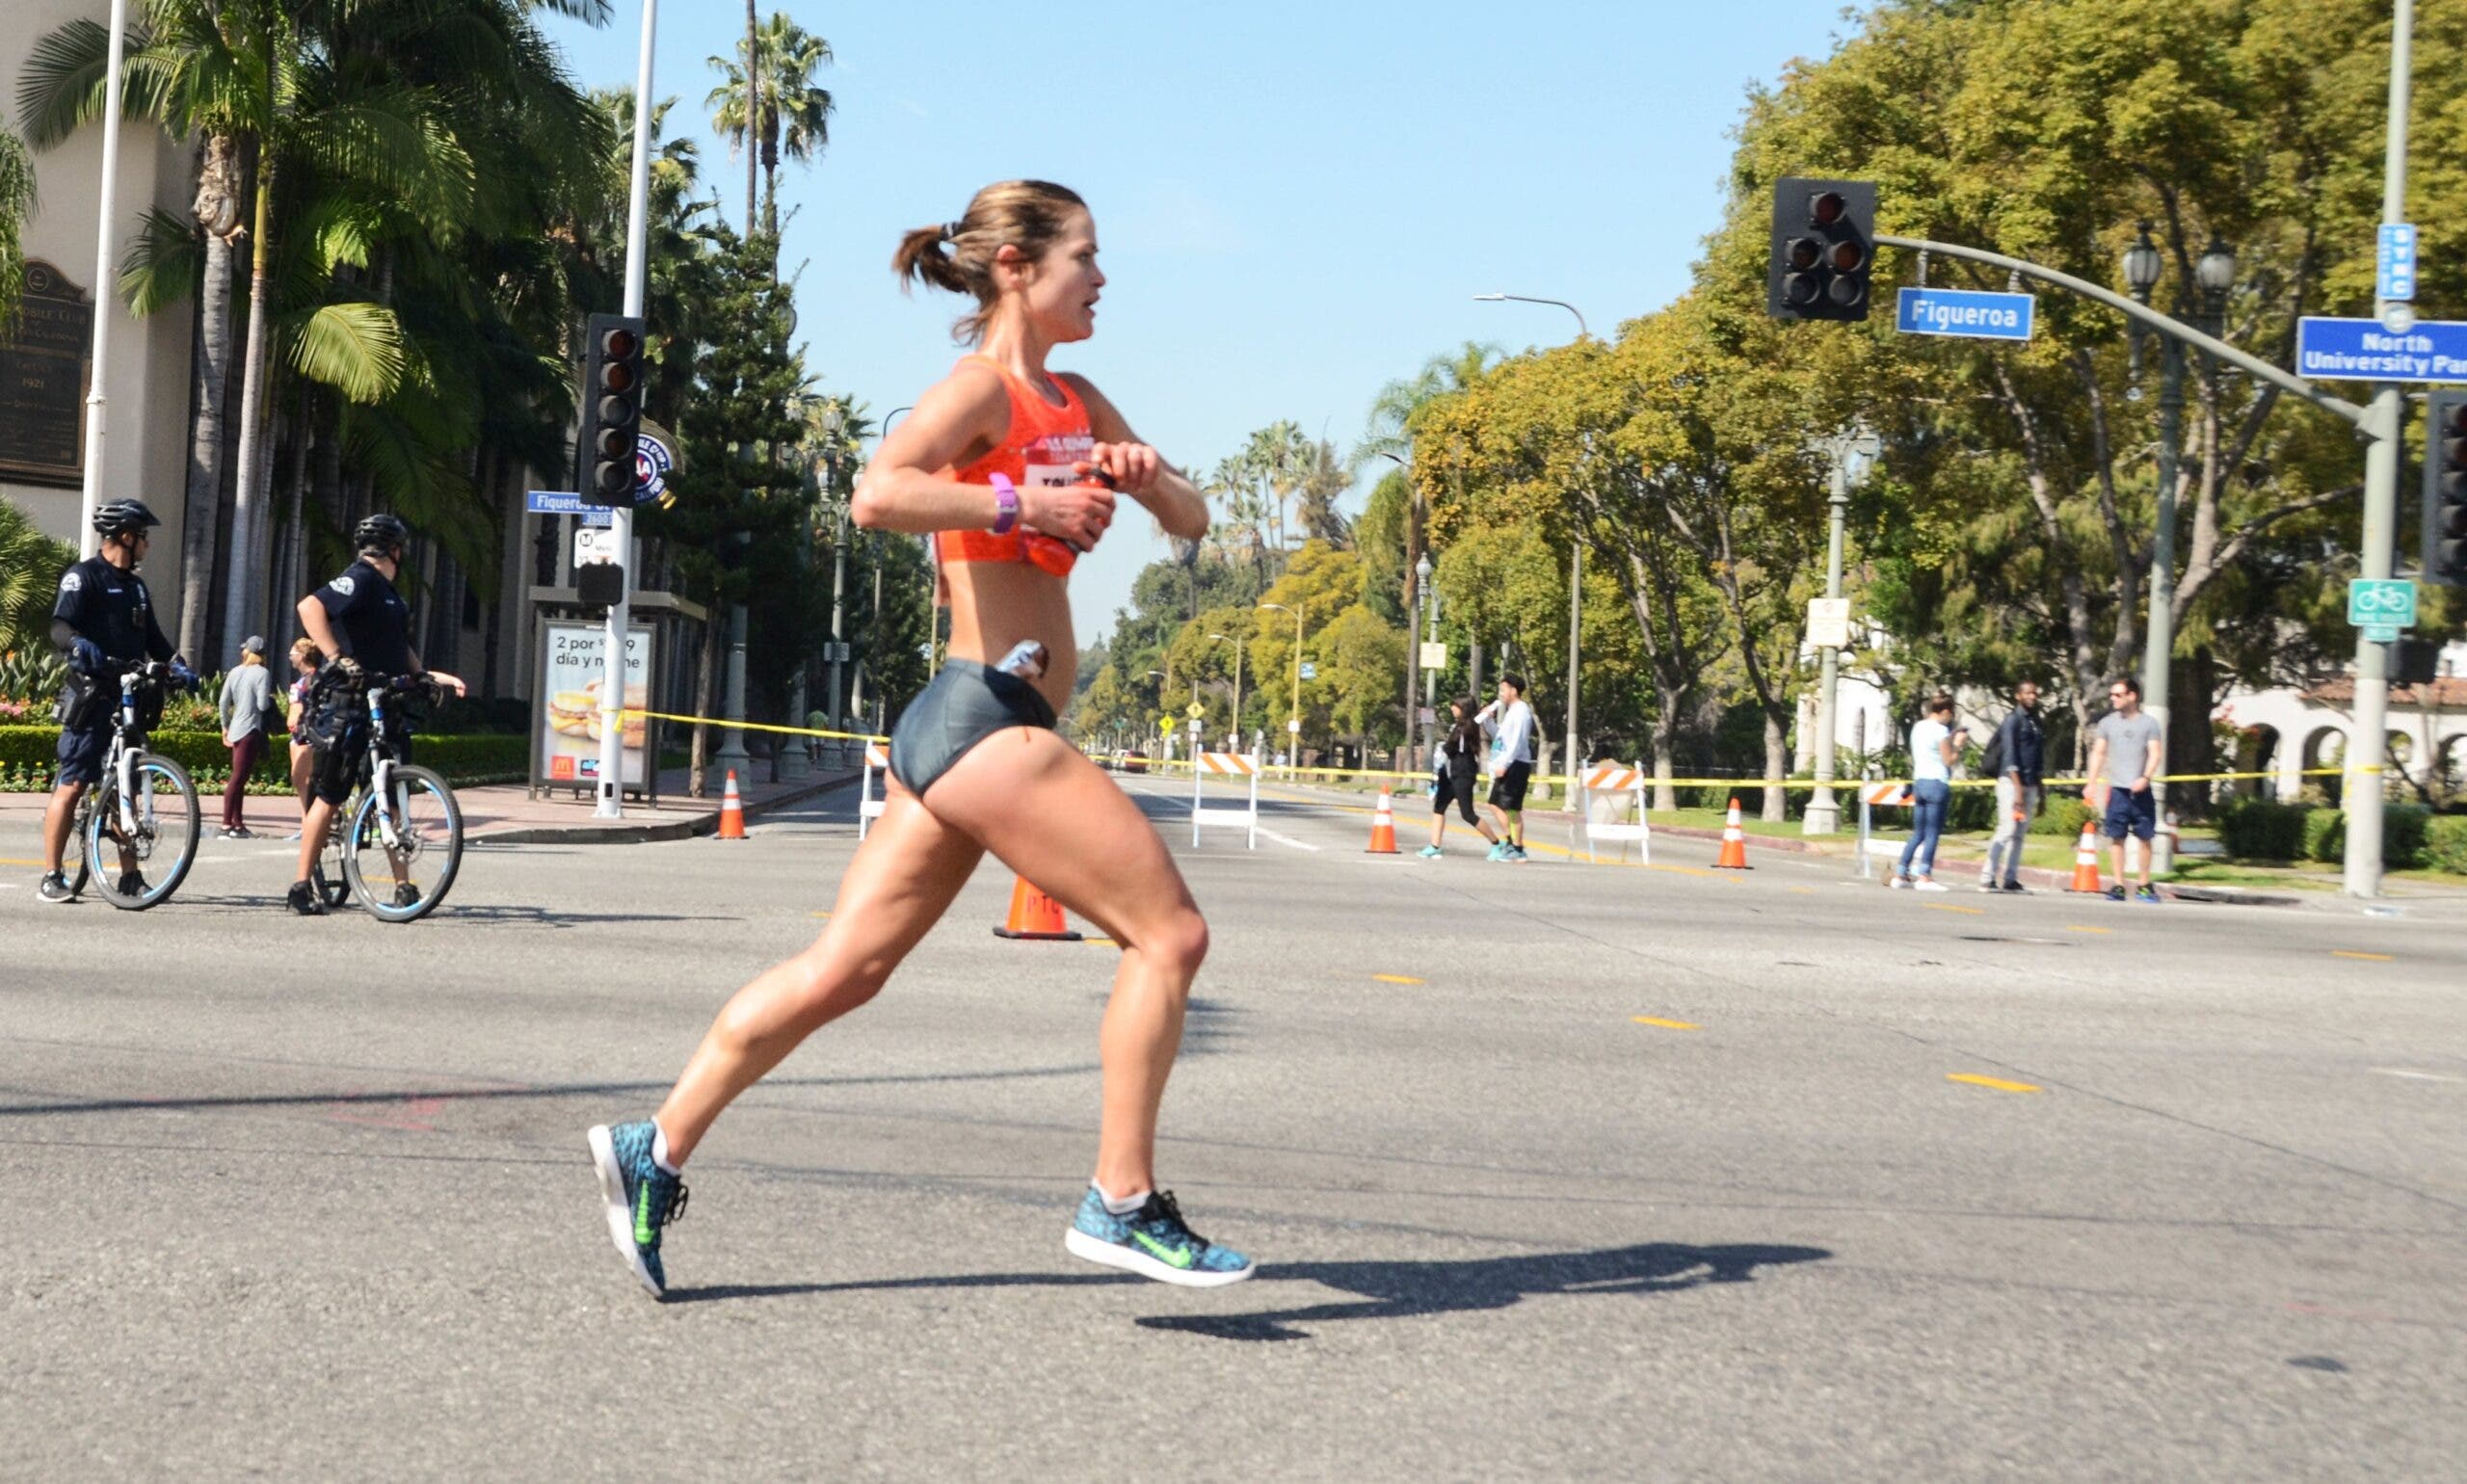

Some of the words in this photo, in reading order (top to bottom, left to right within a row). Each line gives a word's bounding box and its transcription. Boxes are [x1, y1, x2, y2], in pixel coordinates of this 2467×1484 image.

[1911, 299, 2018, 331] Figueroa
[2362, 332, 2433, 353] North
[2305, 351, 2431, 377] University
[2432, 355, 2467, 375] Par
[557, 637, 567, 649] 2
[570, 639, 595, 651] por
[556, 652, 578, 666] día
[582, 657, 591, 669] y
